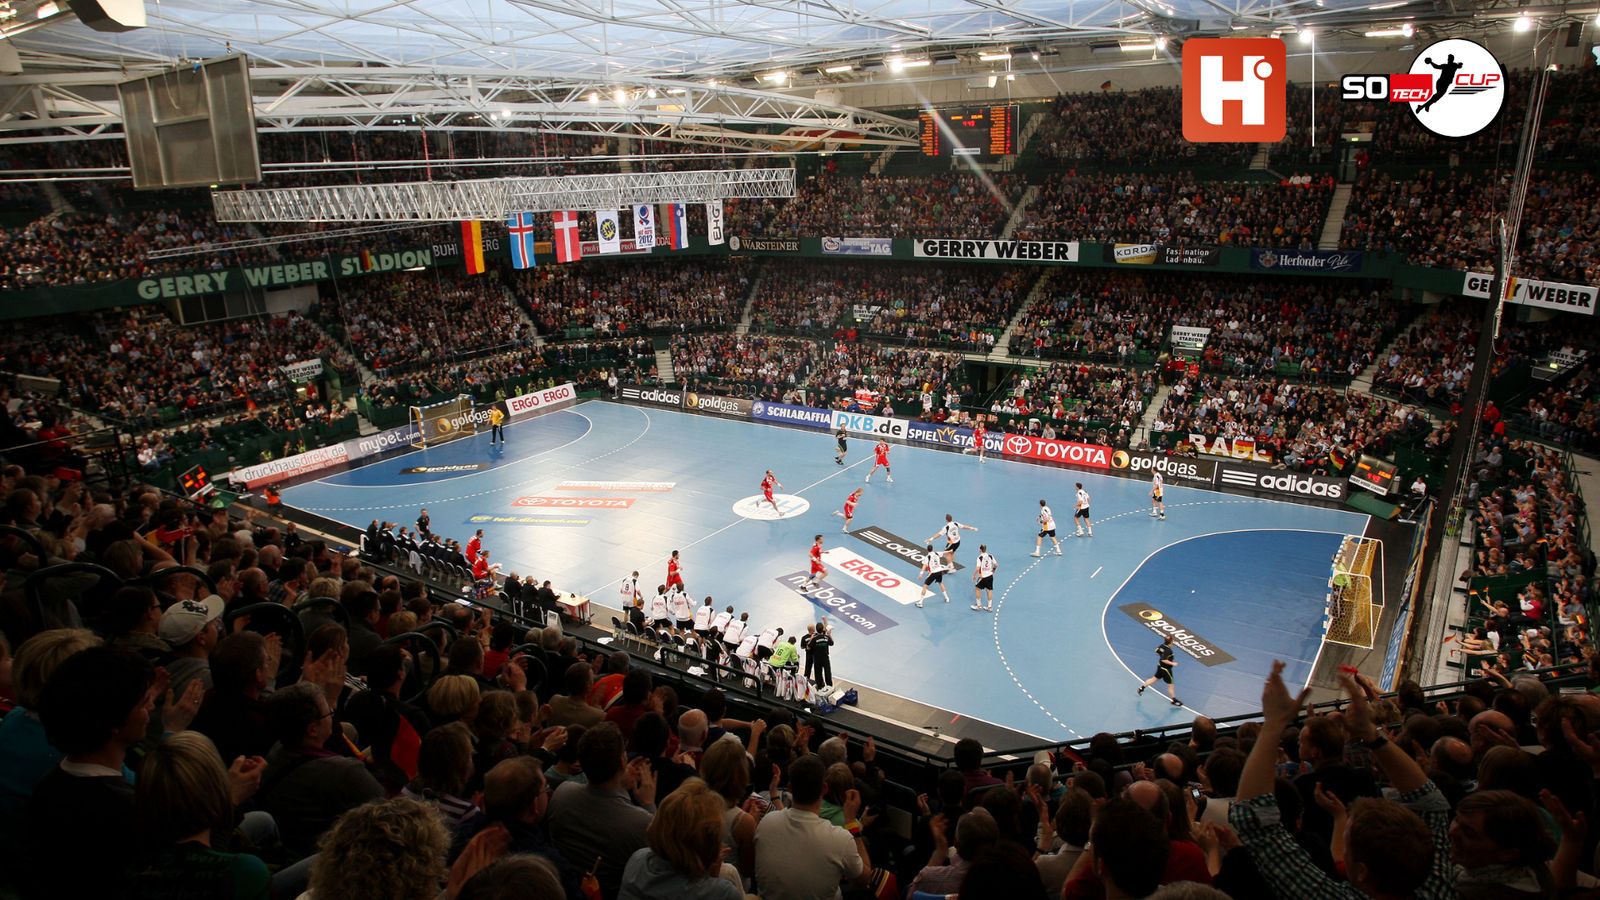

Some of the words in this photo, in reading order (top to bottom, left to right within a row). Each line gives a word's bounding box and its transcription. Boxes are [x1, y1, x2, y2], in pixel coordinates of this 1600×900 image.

[638, 235, 653, 244] 2012
[741, 240, 798, 251] WARSTEINER
[870, 244, 891, 253] TAG
[923, 240, 990, 258] GERRY
[994, 241, 1070, 260] WEBER
[1116, 245, 1156, 257] KORDA
[1166, 256, 1205, 264] Ladnbau.
[1280, 255, 1326, 267] Herforder
[137, 271, 229, 300] GERRY
[244, 261, 329, 287] WEBER
[1528, 285, 1591, 308] WEBER
[512, 396, 540, 411] ERGO
[543, 388, 570, 402] ERGO
[641, 390, 680, 404] adidas
[698, 397, 739, 412] goldgas
[451, 408, 493, 430] goldgas
[767, 406, 831, 424] SCHLARAFFIA
[836, 413, 902, 436] DKB.de
[359, 431, 421, 453] mybet.com
[908, 428, 939, 442] SPIEL
[1035, 440, 1107, 465] TOYOTA
[244, 446, 345, 481] druckhausdirekt.de
[1131, 455, 1198, 476] goldgas
[1260, 474, 1342, 498] adidas
[549, 499, 628, 507] TOYOTA
[840, 558, 901, 589] ERGO
[1151, 620, 1215, 657] goldgas
